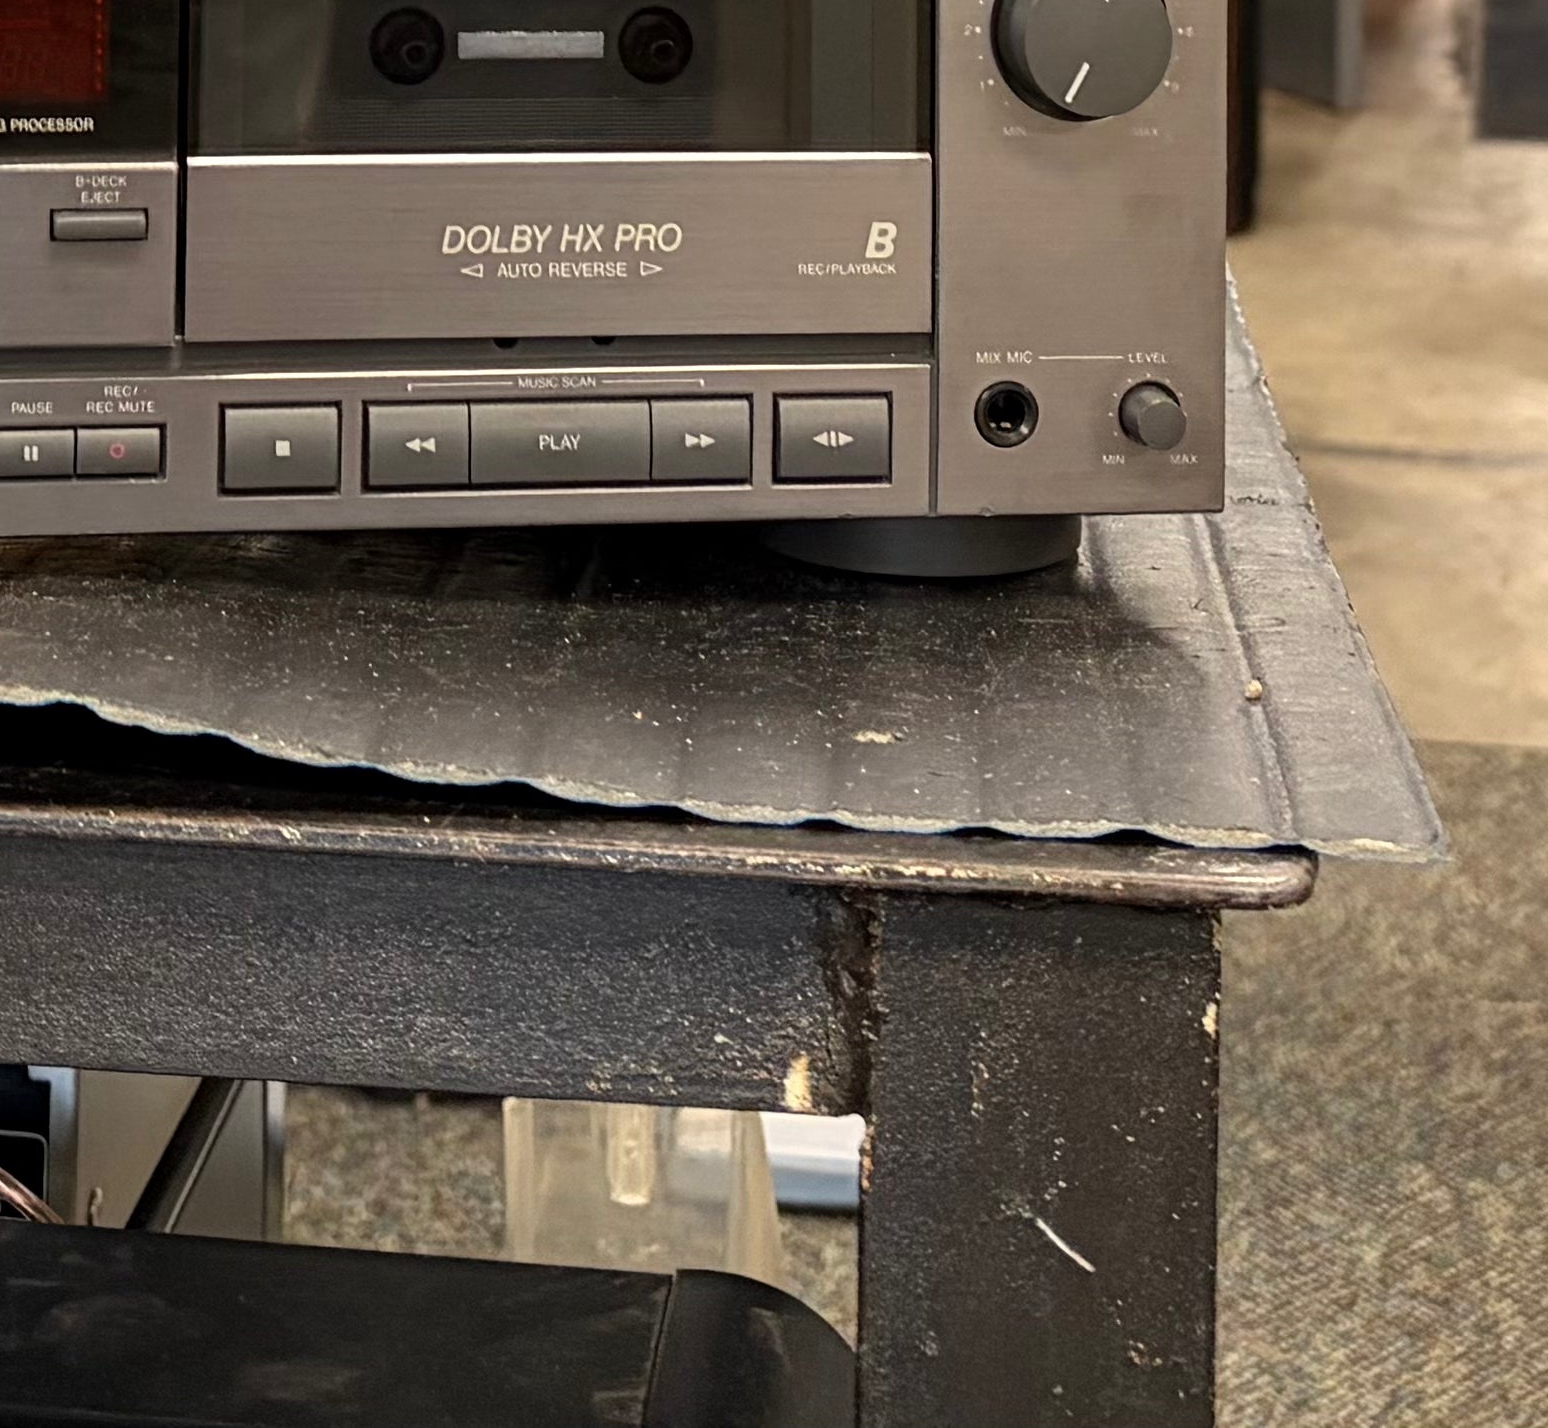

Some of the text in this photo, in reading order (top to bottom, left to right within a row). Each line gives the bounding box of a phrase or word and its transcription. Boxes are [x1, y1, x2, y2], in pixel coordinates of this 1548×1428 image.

[963, 23, 974, 37] 2
[10, 117, 95, 134] PROCESSOR
[81, 190, 121, 204] EJECT
[441, 222, 684, 254] DOLBY HX PRO
[864, 221, 898, 259] B
[497, 261, 628, 278] AUTO REVERSE
[797, 262, 897, 275] REC/PLAYBACK
[975, 350, 1033, 365] MIX MIC
[1127, 352, 1169, 364] LEVEL
[518, 375, 596, 389] MUSIC SCAN
[103, 385, 139, 398] REC/
[11, 401, 54, 415] PAUSE
[86, 400, 155, 415] REC MUTE
[538, 434, 581, 452] PLAY
[1102, 455, 1126, 465] MIN
[1169, 454, 1199, 465] MAX
